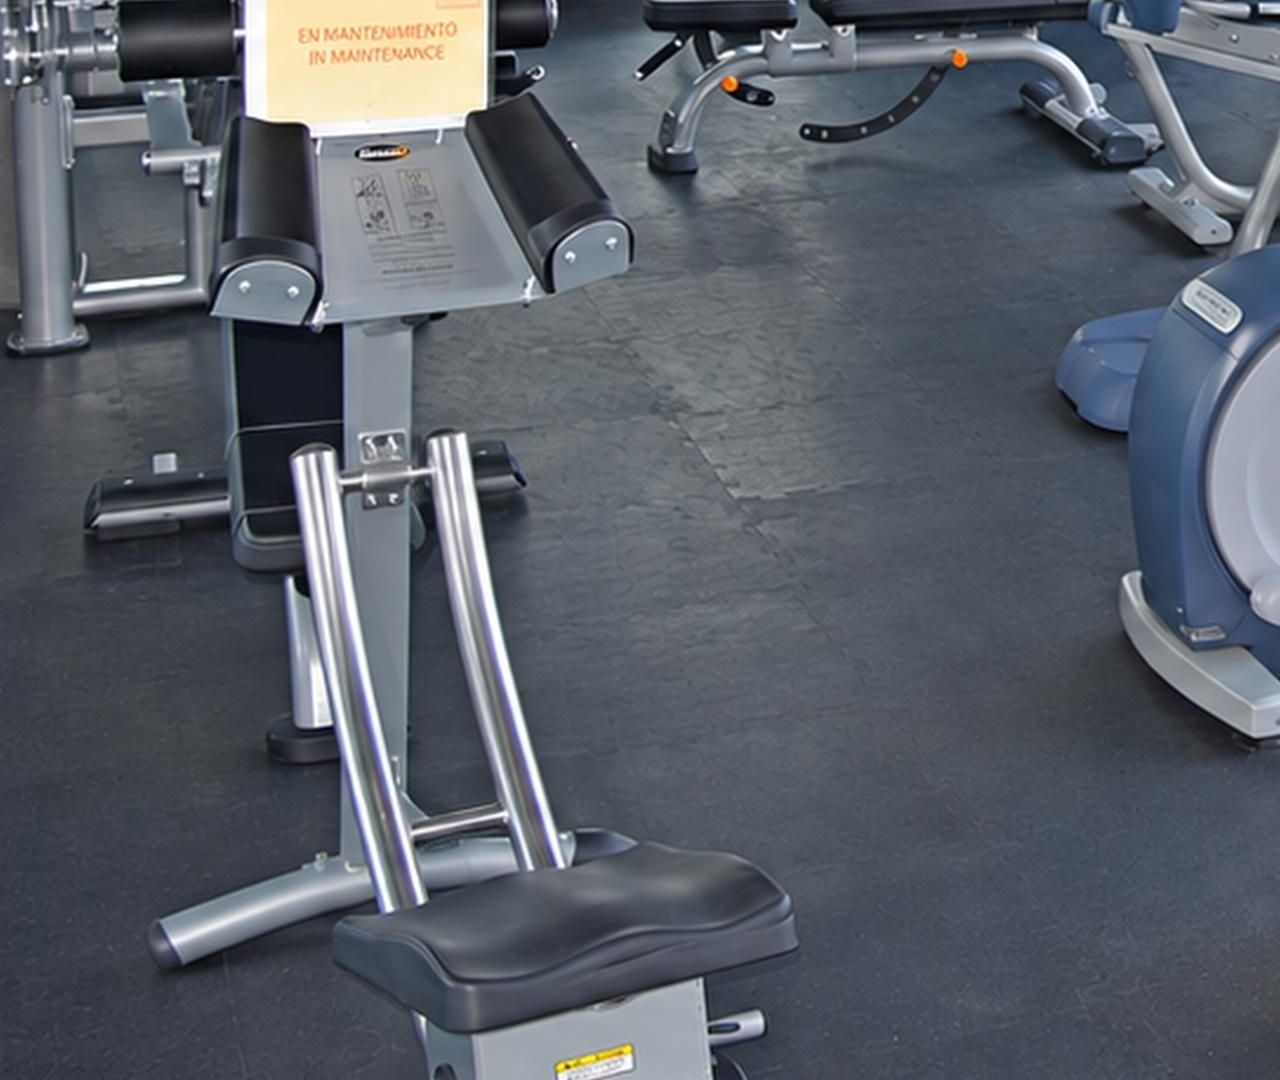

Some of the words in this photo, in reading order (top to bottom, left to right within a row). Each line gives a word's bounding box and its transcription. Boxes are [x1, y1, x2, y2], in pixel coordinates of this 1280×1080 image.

[298, 27, 320, 44] EN
[323, 21, 458, 41] MANTENIMIENTO
[309, 49, 326, 65] IN
[331, 45, 445, 64] MAINTENANCE
